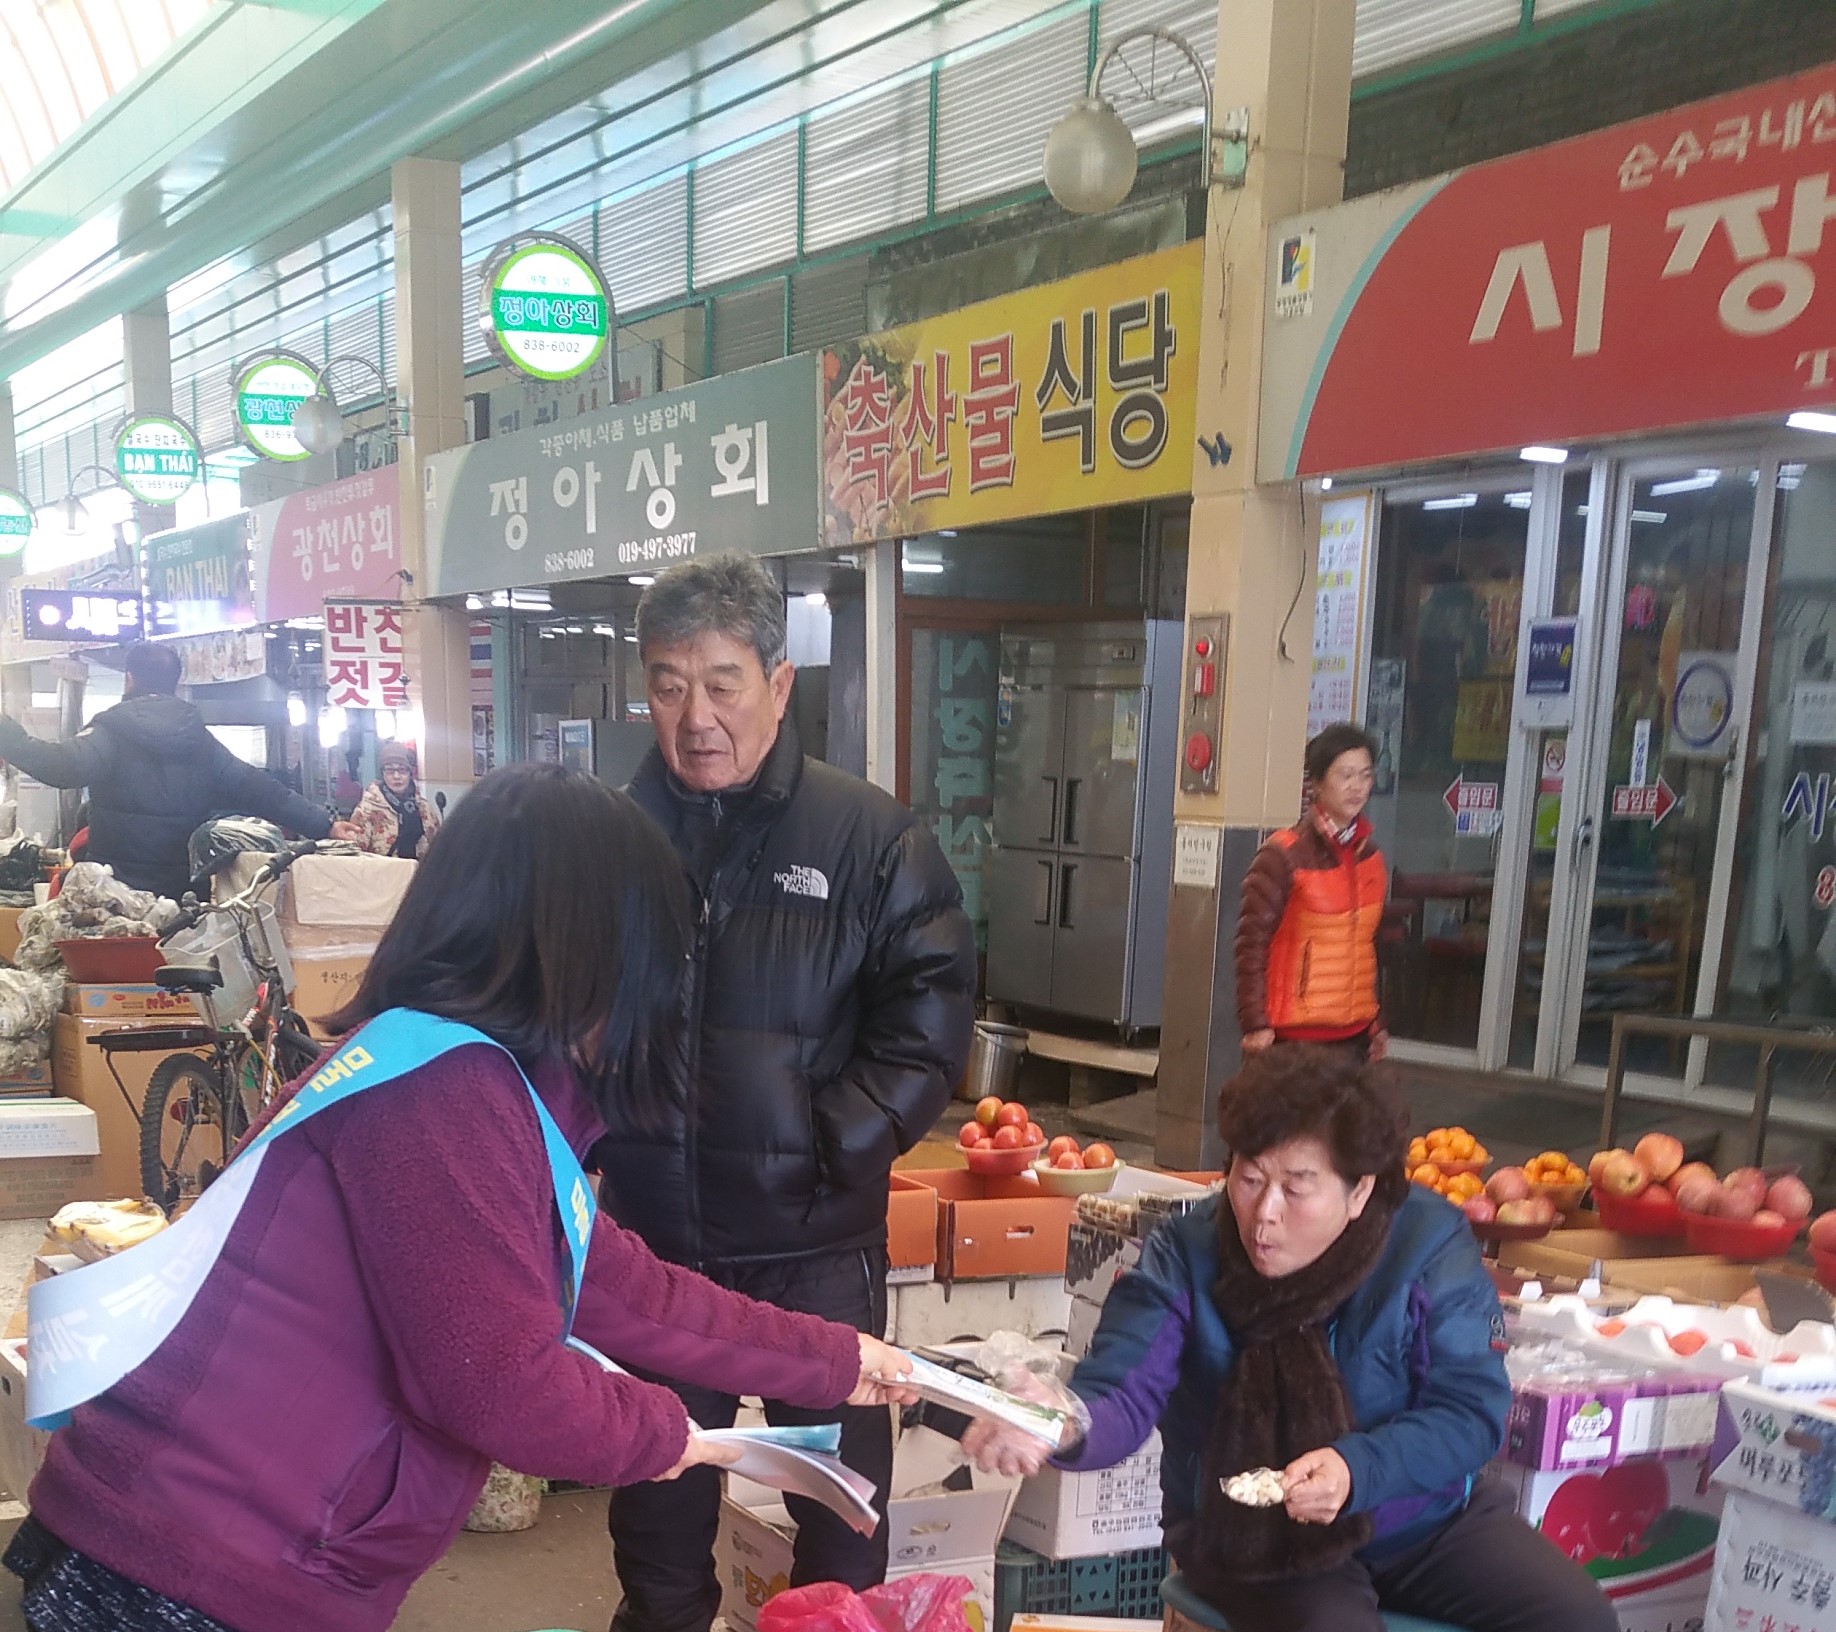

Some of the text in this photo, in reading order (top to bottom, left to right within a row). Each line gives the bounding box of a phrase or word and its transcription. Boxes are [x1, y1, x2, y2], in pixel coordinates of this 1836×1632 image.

[499, 296, 599, 329] 정아상회
[523, 339, 580, 353] 838-6002
[844, 287, 1177, 508] 축산물 식당
[632, 399, 696, 437] 납품업체
[488, 419, 769, 551] 정아상회
[292, 503, 394, 582] 광천상회
[773, 871, 811, 887] NORTH
[790, 864, 811, 877] THE
[783, 882, 811, 896] FACE
